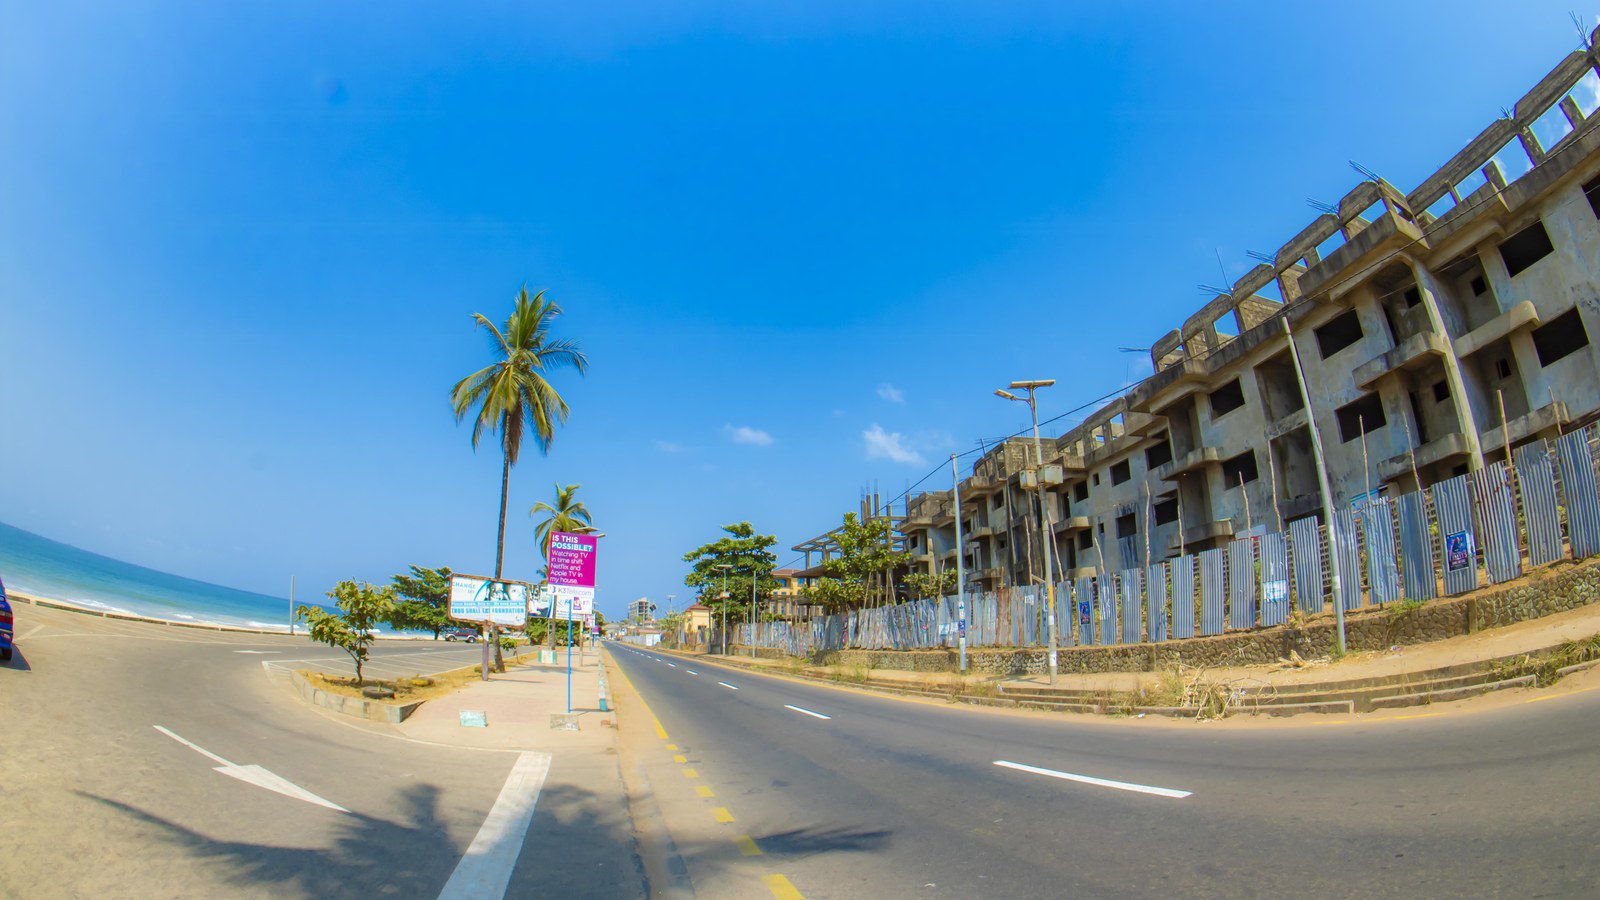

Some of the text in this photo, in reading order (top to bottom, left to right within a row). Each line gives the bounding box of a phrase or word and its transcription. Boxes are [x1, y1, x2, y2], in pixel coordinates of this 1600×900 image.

[552, 534, 579, 544] IS THIS
[552, 542, 593, 551] POSSIBLE?
[552, 550, 579, 558] Watching
[550, 569, 567, 577] Apple
